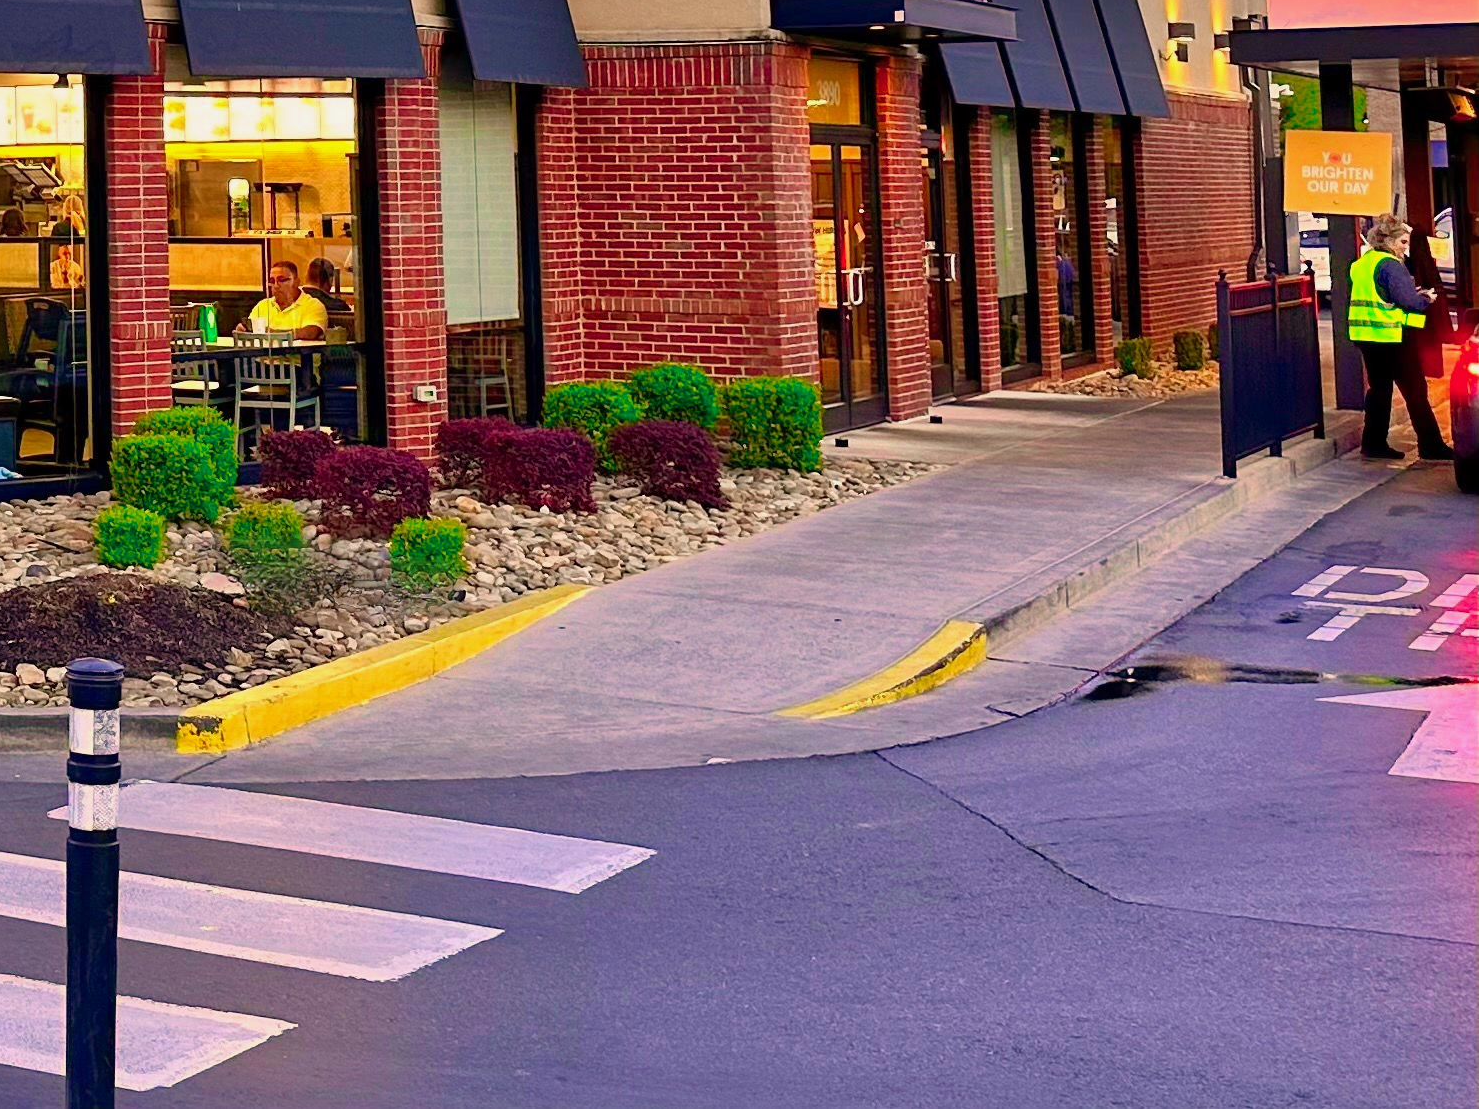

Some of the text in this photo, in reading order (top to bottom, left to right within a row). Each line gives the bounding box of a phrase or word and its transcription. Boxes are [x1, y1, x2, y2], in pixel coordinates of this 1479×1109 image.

[816, 79, 841, 107] 3890
[1321, 151, 1352, 166] YOU
[1301, 165, 1374, 181] BRIGHTEN
[1307, 180, 1370, 196] OUR DAY
